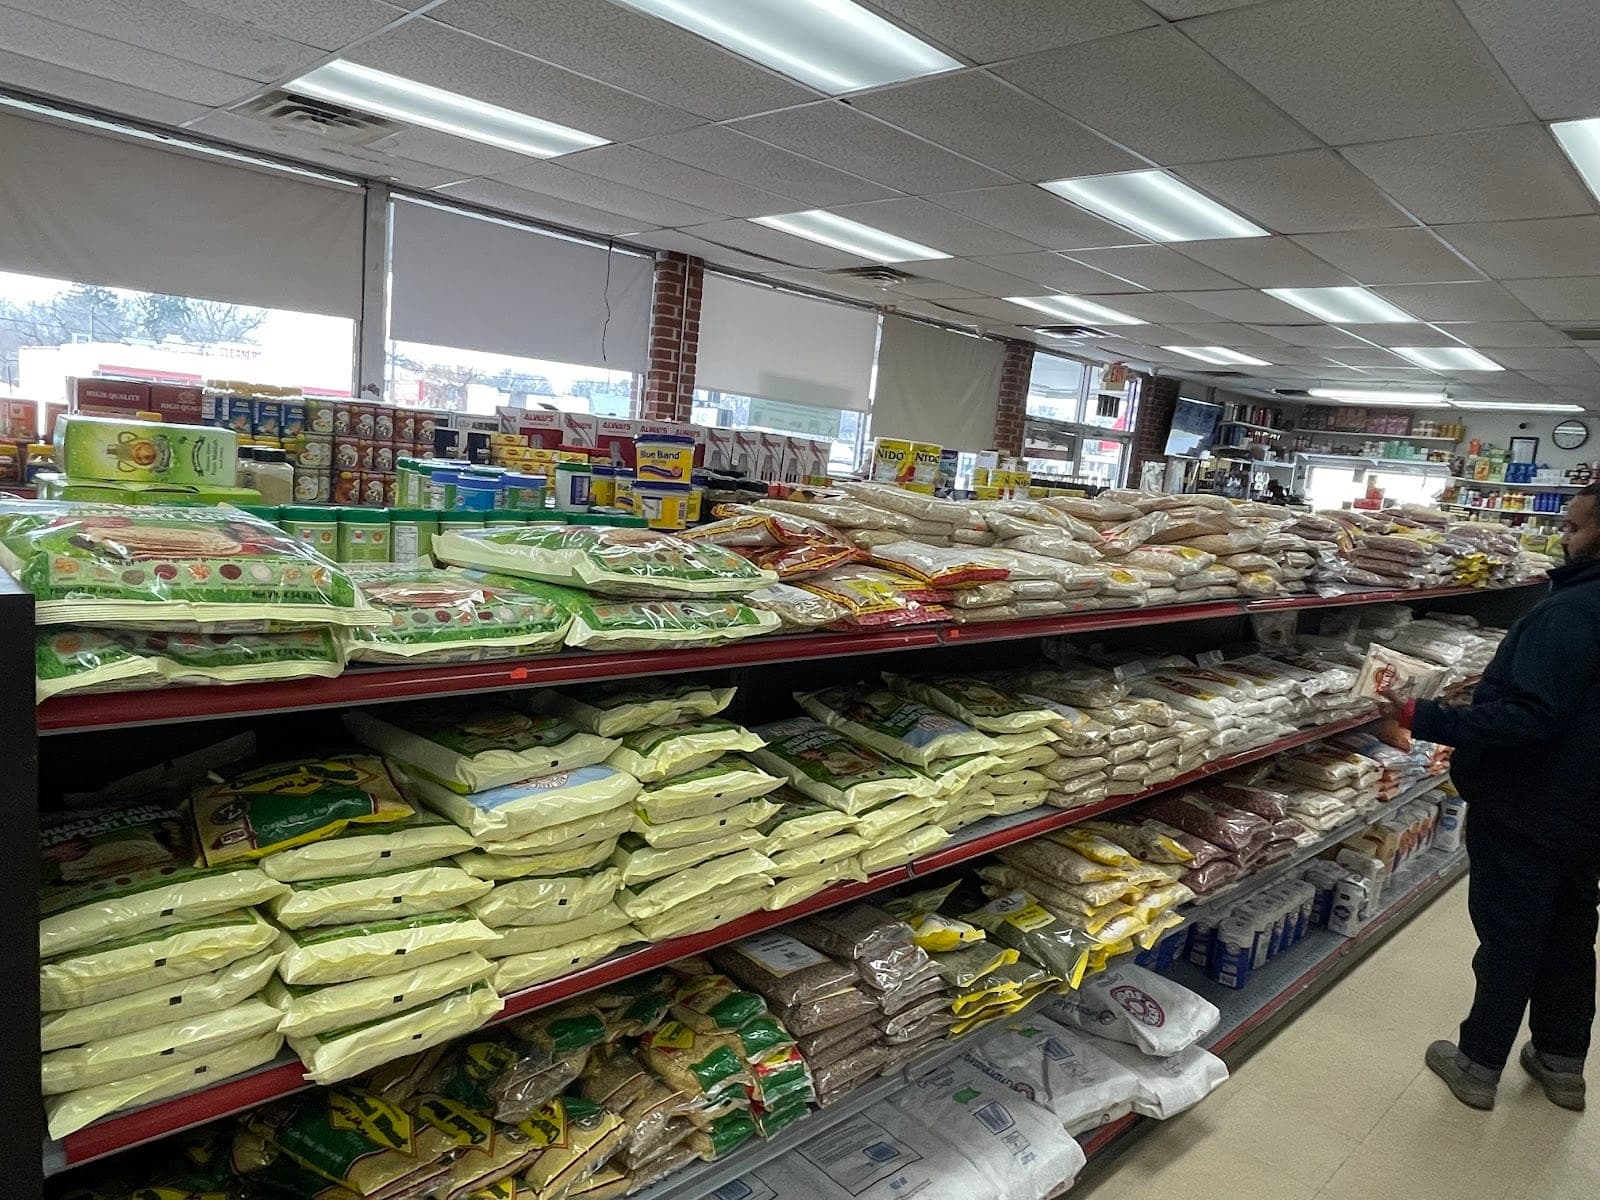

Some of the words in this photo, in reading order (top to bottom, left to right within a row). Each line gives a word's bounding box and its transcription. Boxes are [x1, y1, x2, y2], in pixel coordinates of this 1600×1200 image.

[86, 389, 107, 399] HIGH
[108, 391, 140, 402] QUALITY
[160, 402, 179, 411] HIGH
[180, 404, 201, 412] QUALI
[523, 413, 554, 422] ALWAYS
[602, 422, 631, 431] ALWAYS
[640, 425, 668, 434] ALWAYS
[640, 448, 656, 459] Blue
[657, 449, 680, 460] Band
[875, 448, 904, 461] NIDO
